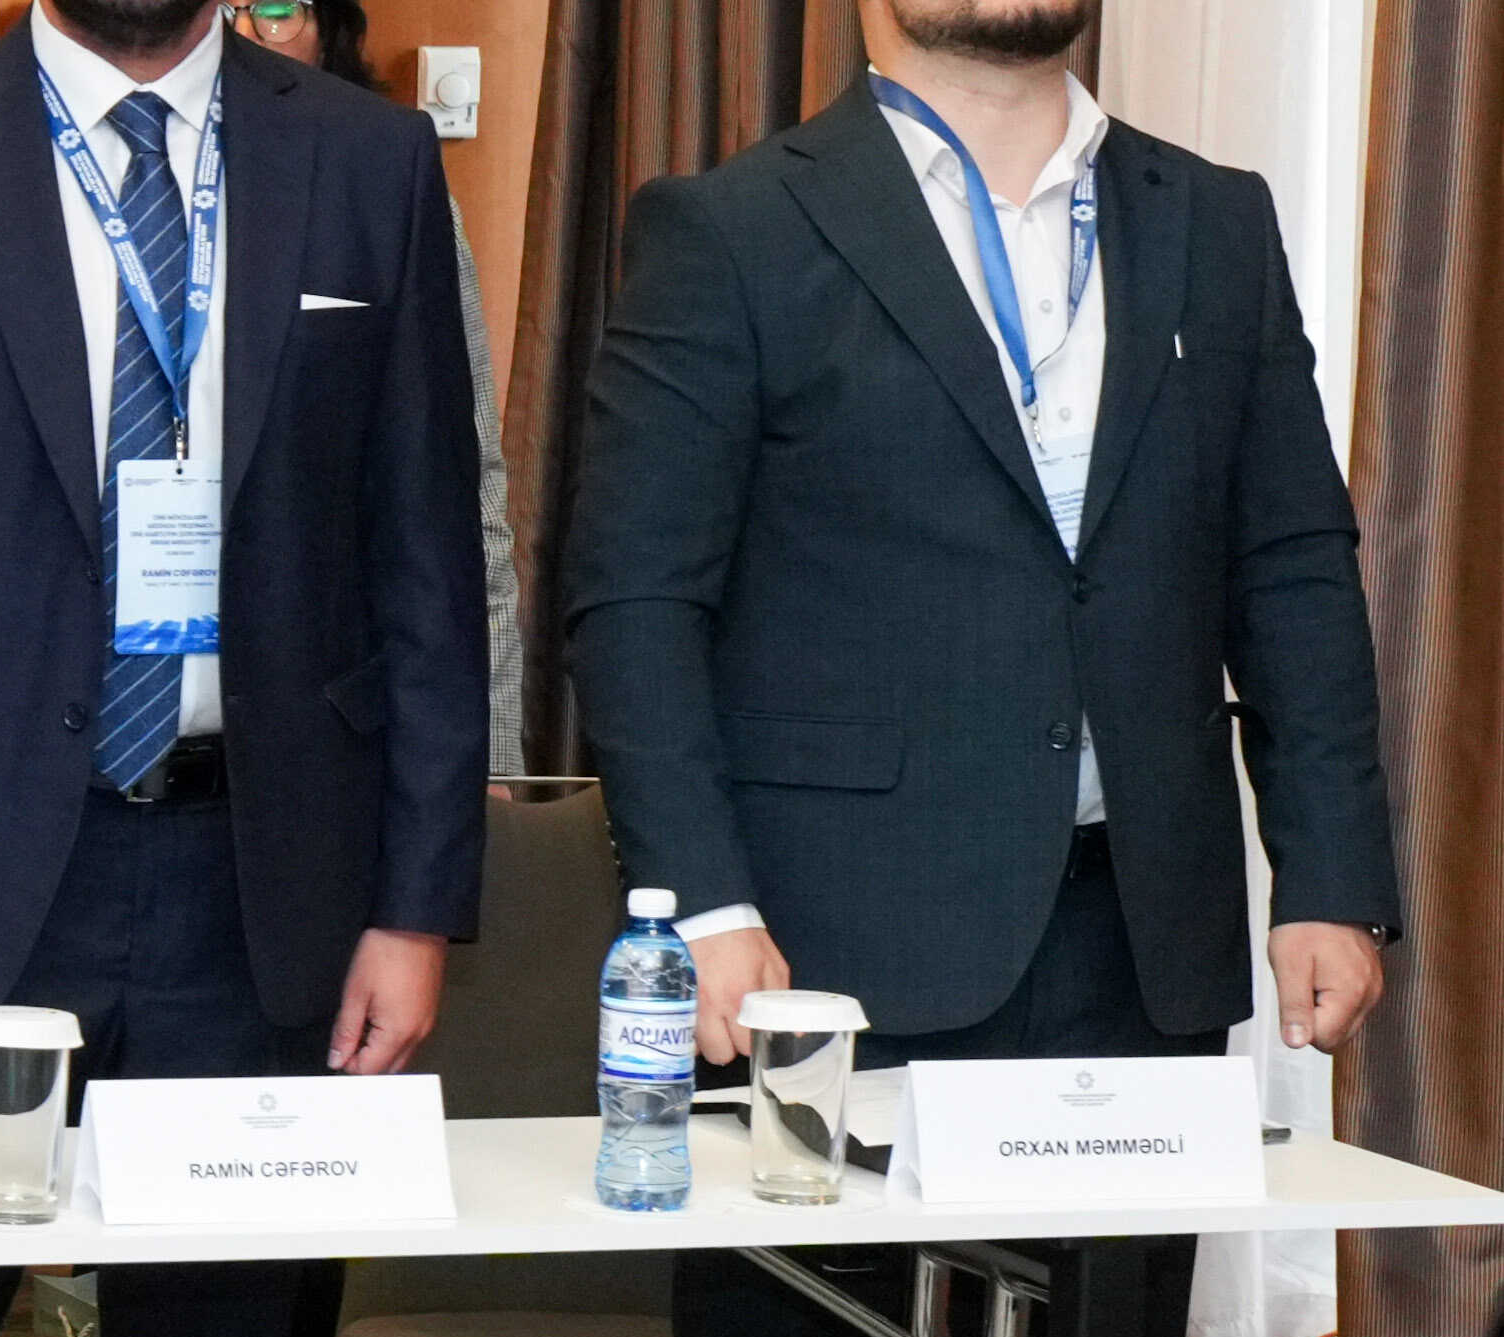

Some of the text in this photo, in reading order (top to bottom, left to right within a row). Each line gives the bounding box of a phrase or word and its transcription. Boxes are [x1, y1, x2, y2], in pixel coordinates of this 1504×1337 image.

[998, 1133, 1186, 1157] ORXAN MƏMMƏDLİ
[189, 1157, 359, 1180] RAMİN CƏFƏROV
